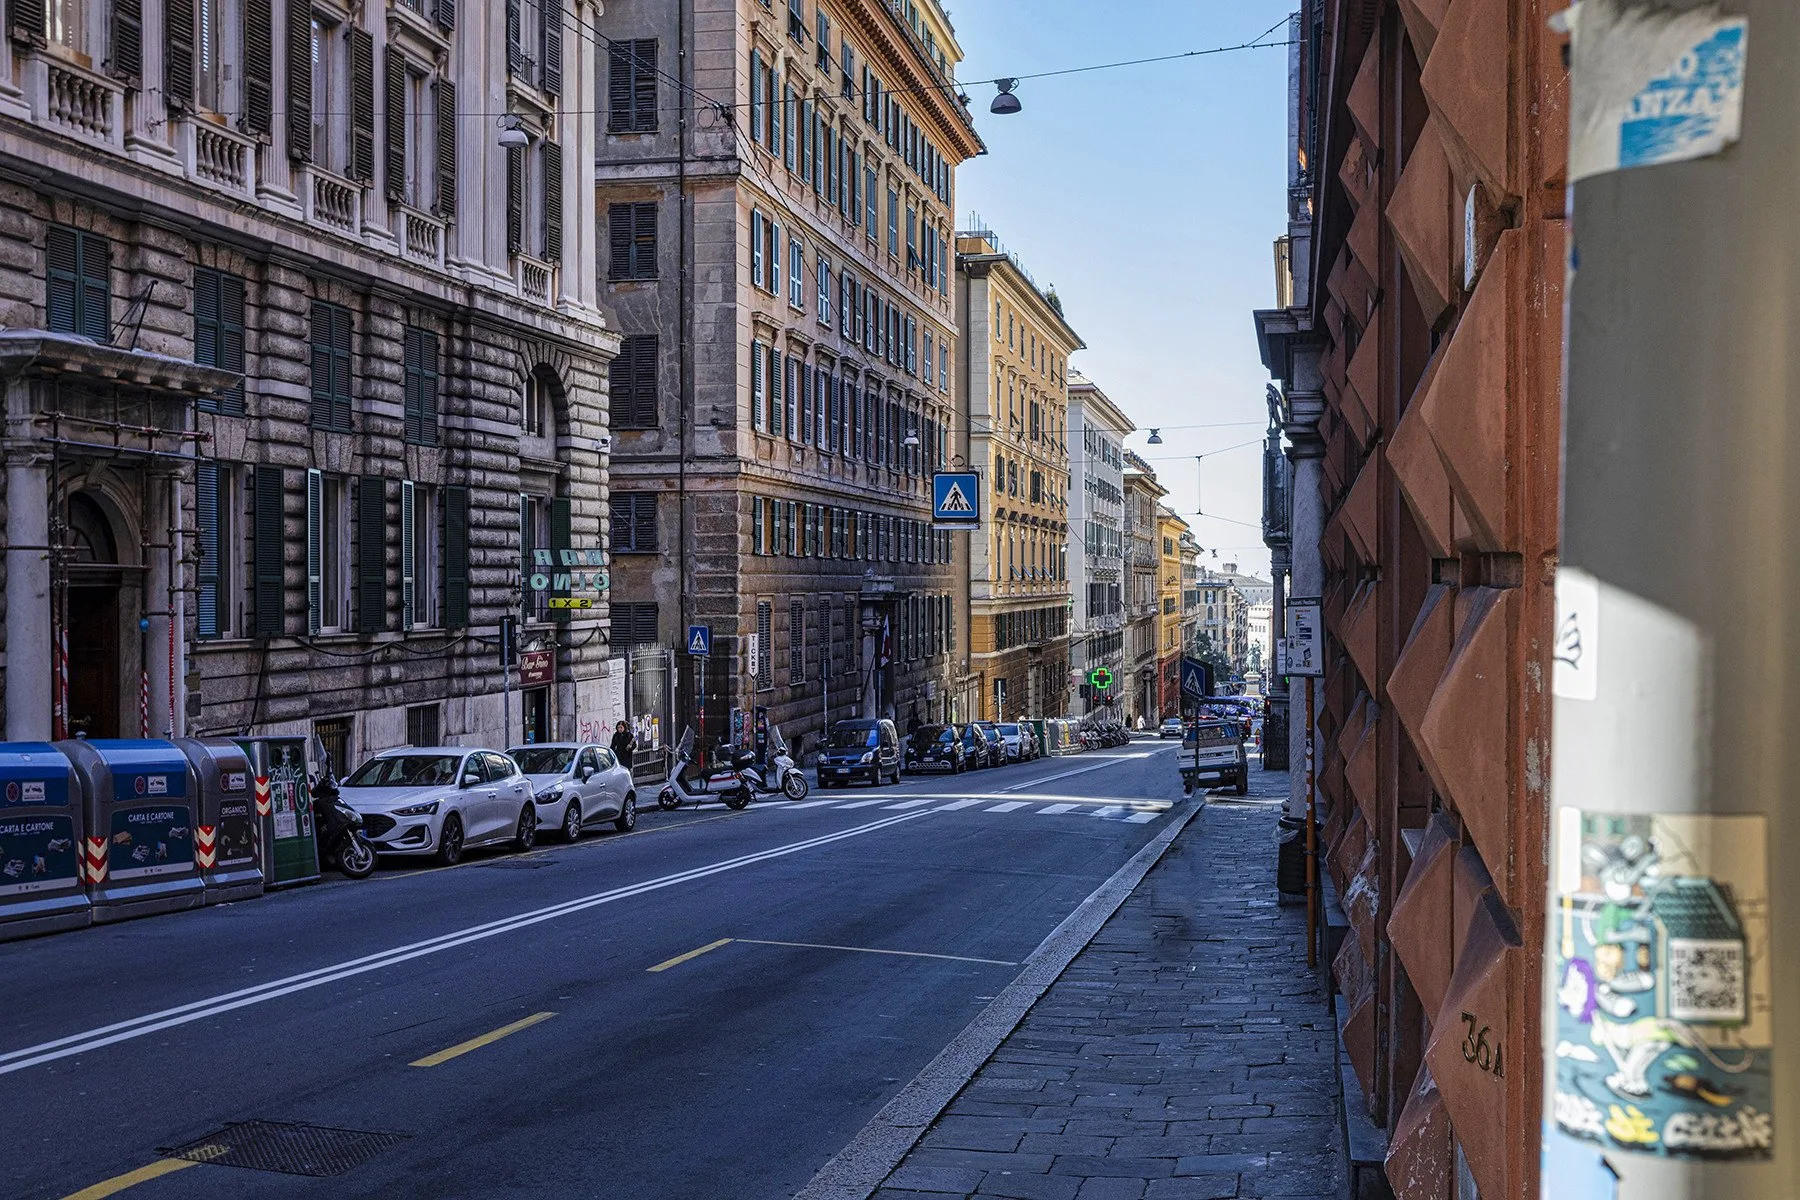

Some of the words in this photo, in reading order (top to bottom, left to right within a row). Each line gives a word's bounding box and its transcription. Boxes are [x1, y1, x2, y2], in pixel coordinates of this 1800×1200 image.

[221, 805, 247, 815] ORGANICO
[127, 813, 146, 823] CARTA
[146, 812, 150, 821] E
[150, 811, 175, 821] CARTONE
[20, 823, 25, 833] E
[25, 821, 54, 832] CARTONE
[1461, 1010, 1505, 1078] 36A
